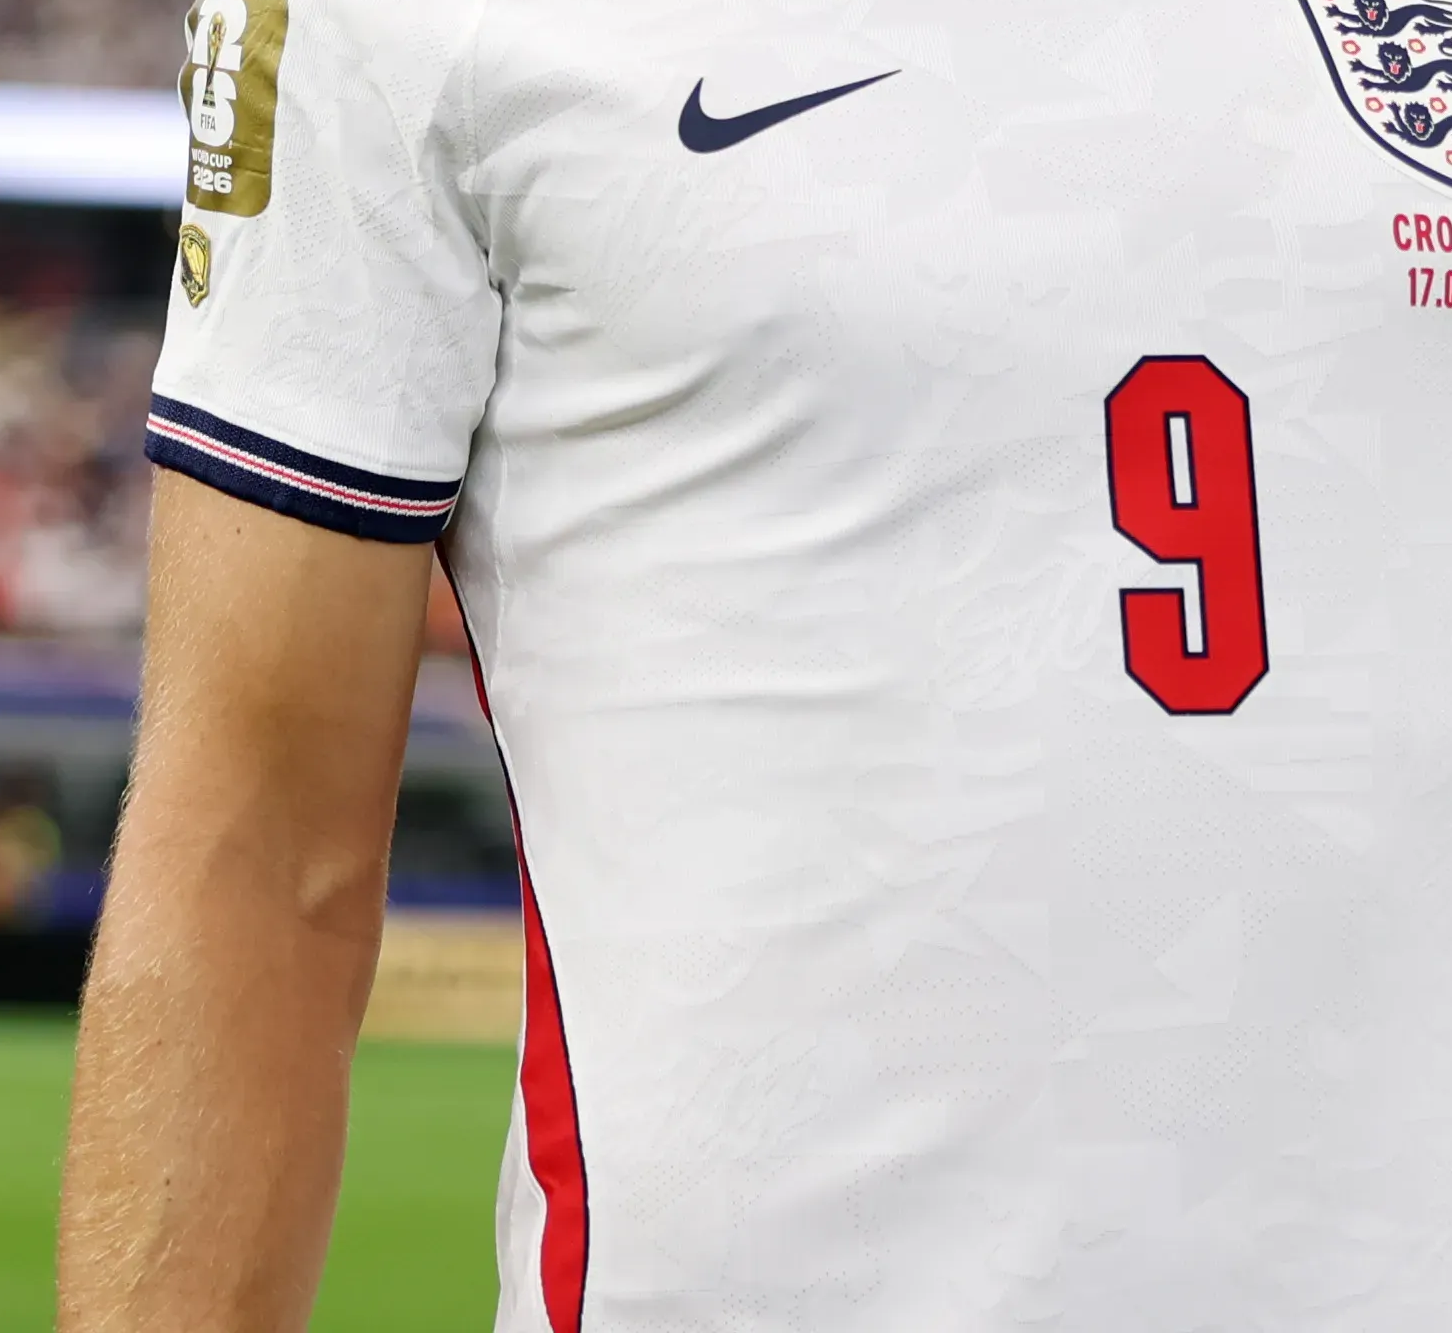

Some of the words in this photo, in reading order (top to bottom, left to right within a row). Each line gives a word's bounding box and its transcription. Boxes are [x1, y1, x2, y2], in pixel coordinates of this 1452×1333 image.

[200, 113, 216, 132] FIFA
[209, 153, 233, 169] CUP
[192, 164, 232, 194] 226
[1104, 355, 1269, 715] 9
